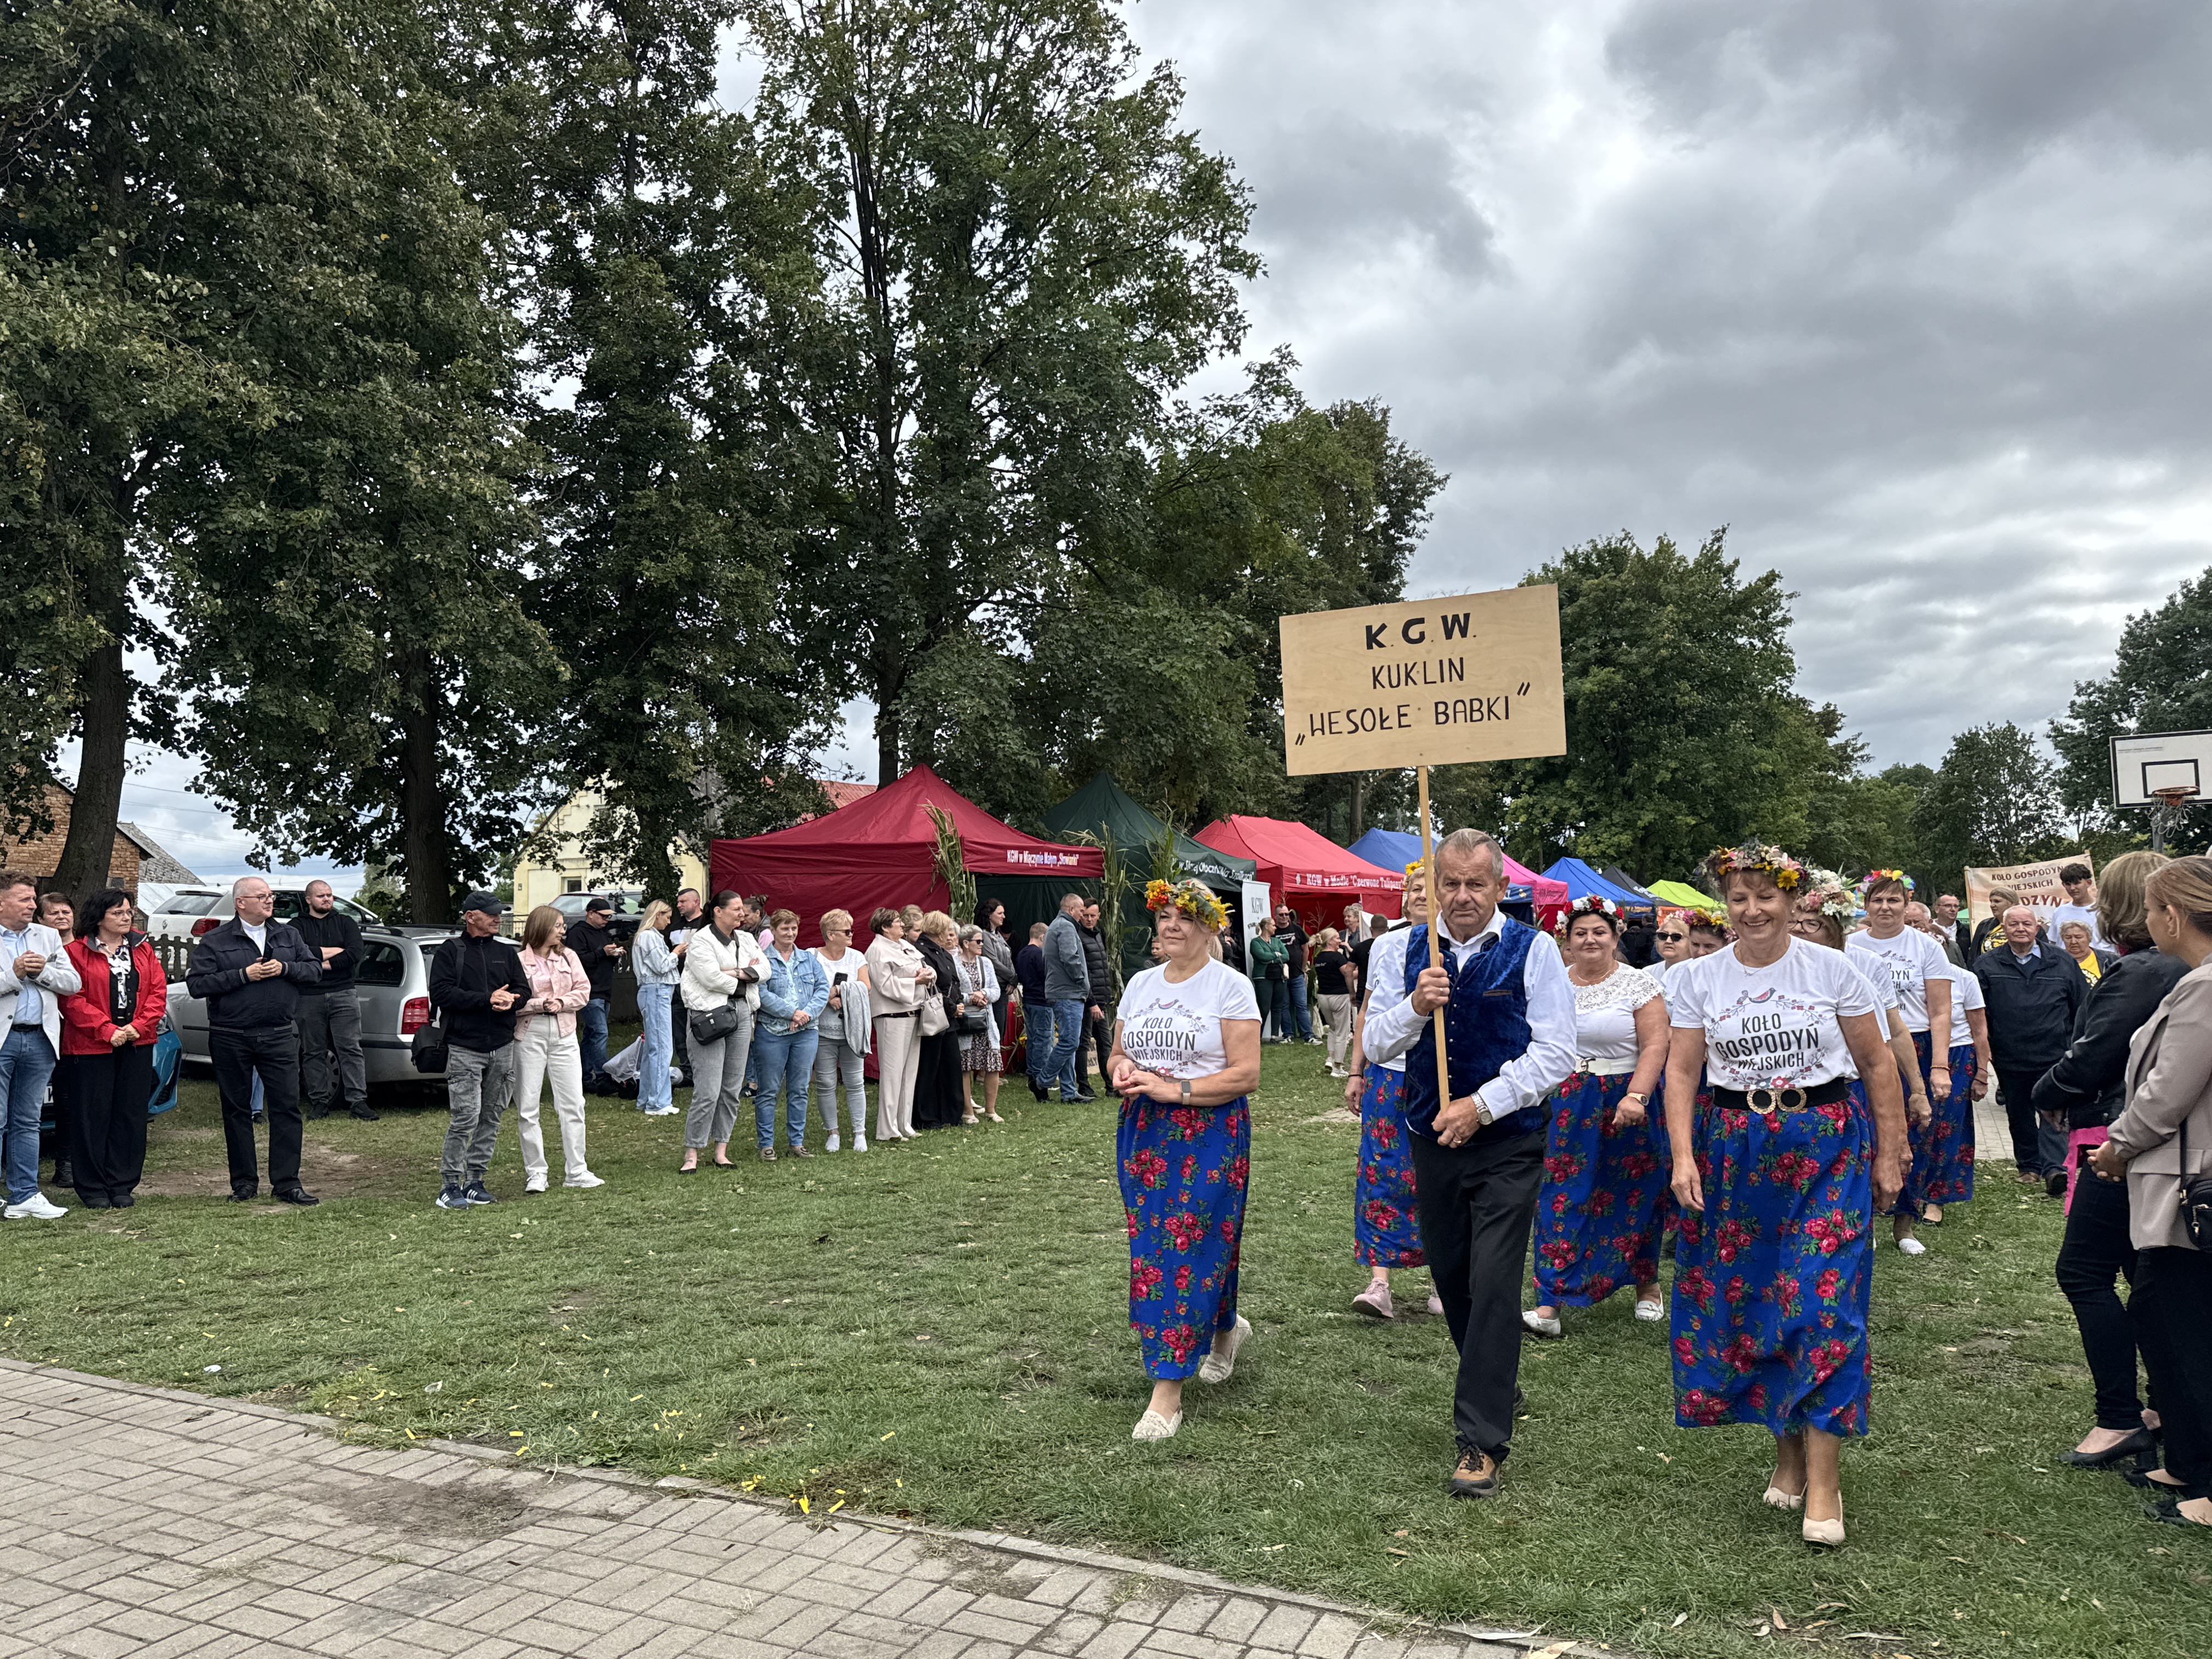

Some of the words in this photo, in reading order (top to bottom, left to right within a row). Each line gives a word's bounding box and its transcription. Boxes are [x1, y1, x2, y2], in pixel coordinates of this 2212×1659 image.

[1372, 657, 1464, 689] KUKLIN
[1007, 849, 1019, 863] KGW
[1019, 853, 1023, 863] w
[1306, 873, 1322, 887] KGW
[1323, 878, 1329, 887] w
[1330, 874, 1348, 887] Modle
[1251, 897, 1263, 913] KGW
[1142, 1017, 1172, 1029] KOŁO
[1742, 1013, 1781, 1034] KOŁO
[1122, 1030, 1195, 1051] GOSPODYŃ
[1716, 1023, 1819, 1059] GOSPODYŃ
[1131, 1048, 1182, 1061] WIEJSKICH
[1738, 1052, 1804, 1071] WIEJSKICH
